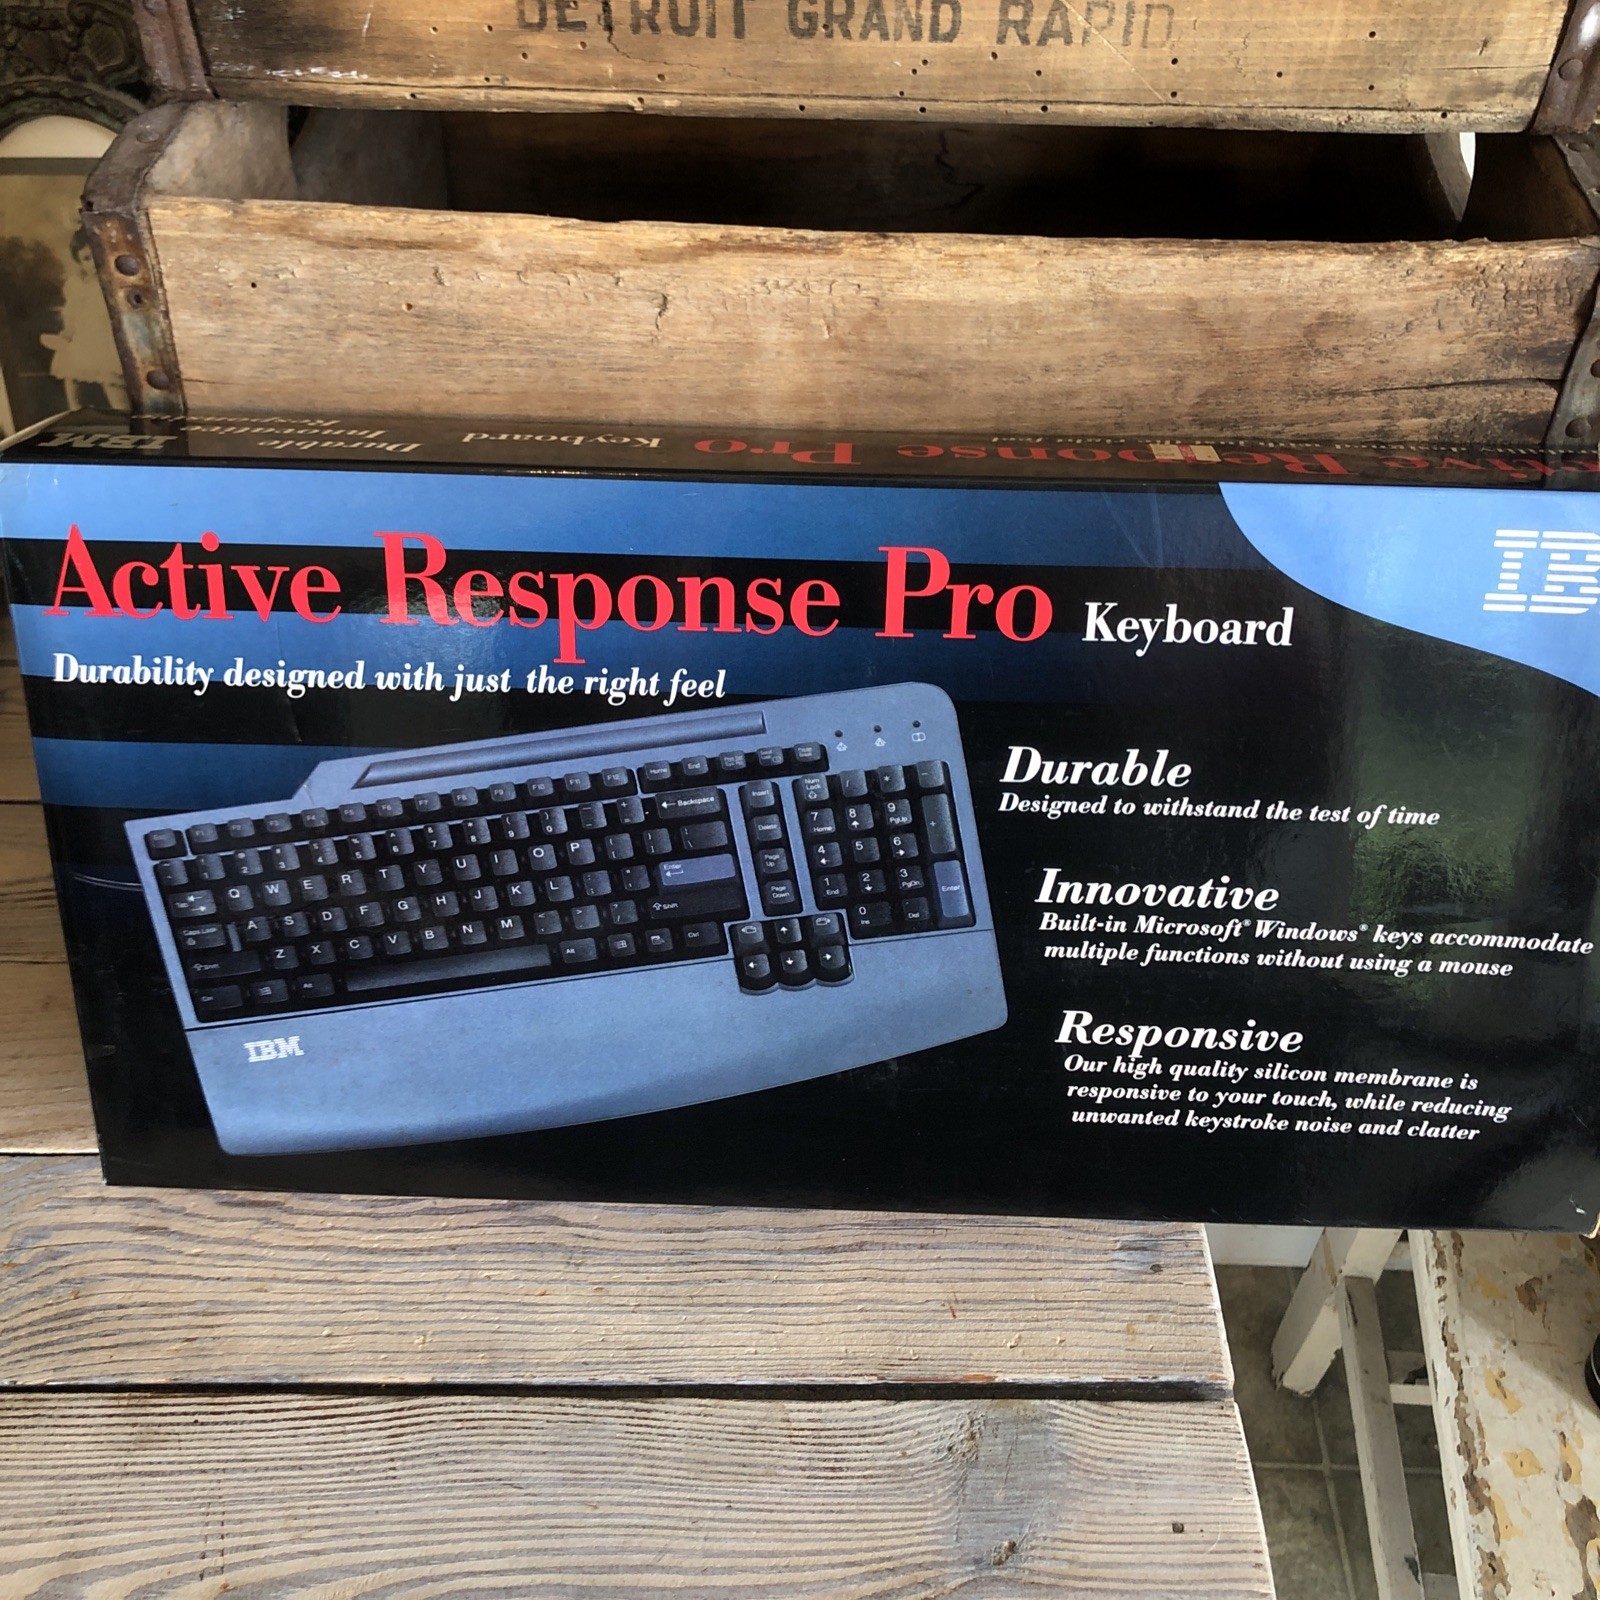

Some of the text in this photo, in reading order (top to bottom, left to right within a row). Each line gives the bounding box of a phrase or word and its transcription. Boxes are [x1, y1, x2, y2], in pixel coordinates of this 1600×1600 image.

[518, 0, 745, 39] DETROIT
[788, 0, 962, 43] GRAND
[180, 425, 387, 438] Innovative
[38, 433, 179, 450] IBM
[461, 432, 664, 449] Keyboard
[258, 440, 424, 453] Durable
[694, 439, 862, 466] Pro
[1378, 452, 1600, 480] ctive
[1482, 529, 1600, 615] IB
[42, 523, 1296, 666] Active Response Pro Keyboard
[52, 652, 726, 707] Durability designed with just the right feel
[687, 762, 701, 770] End
[999, 745, 1192, 788] Durable
[806, 783, 821, 791] Lock
[751, 789, 769, 797] Insert
[677, 795, 715, 807] Backspace
[887, 802, 896, 812] 9
[998, 792, 1441, 830] Designed to withstand the test of time
[810, 811, 819, 821] 7
[848, 808, 857, 818] 8
[758, 823, 778, 831] Delete
[431, 840, 437, 848] 7
[470, 835, 477, 843] 8
[893, 836, 902, 846] 6
[392, 845, 399, 853] 6
[570, 842, 580, 852] P
[817, 845, 826, 854] 4
[855, 841, 864, 850] 5
[355, 851, 363, 859] 5
[533, 847, 545, 858] O
[764, 853, 780, 862] Page
[278, 861, 286, 869] 3
[417, 863, 427, 874] Y
[455, 858, 467, 869] U
[663, 863, 682, 871] Enter
[241, 866, 249, 874] 2
[378, 869, 388, 879] T
[900, 868, 909, 878] 3
[340, 874, 352, 884] R
[824, 877, 831, 886] 1
[862, 873, 871, 882] 2
[265, 884, 281, 894] W
[303, 880, 313, 890] E
[511, 885, 522, 895] K
[550, 881, 559, 890] L
[771, 884, 787, 893] Page
[941, 884, 961, 892] Enter
[1034, 867, 1280, 911] Innovative
[228, 889, 240, 899] Q
[474, 890, 482, 900] J
[772, 891, 790, 899] Down
[397, 900, 408, 911] G
[435, 895, 447, 906] H
[359, 905, 369, 915] F
[662, 902, 679, 910] Shift
[284, 915, 295, 925] S
[322, 911, 333, 921] D
[247, 920, 258, 930] A
[462, 924, 474, 934] N
[500, 919, 513, 929] M
[424, 930, 435, 940] B
[1038, 912, 1594, 954] Built-in Microsoft® Windows® keys accommodate
[349, 939, 360, 949] C
[387, 935, 398, 944] V
[276, 949, 286, 959] Z
[312, 945, 322, 954] X
[1044, 940, 1514, 978] multiple functions without using a mouse
[1054, 1009, 1304, 1059] Responsive
[243, 1035, 304, 1063] IBM
[1064, 1054, 1479, 1090] Our high quality silicon membrane is
[1067, 1083, 1513, 1124] responsive to your touch, while reducing
[1071, 1109, 1481, 1140] unwanted keystroke noise and clatter
